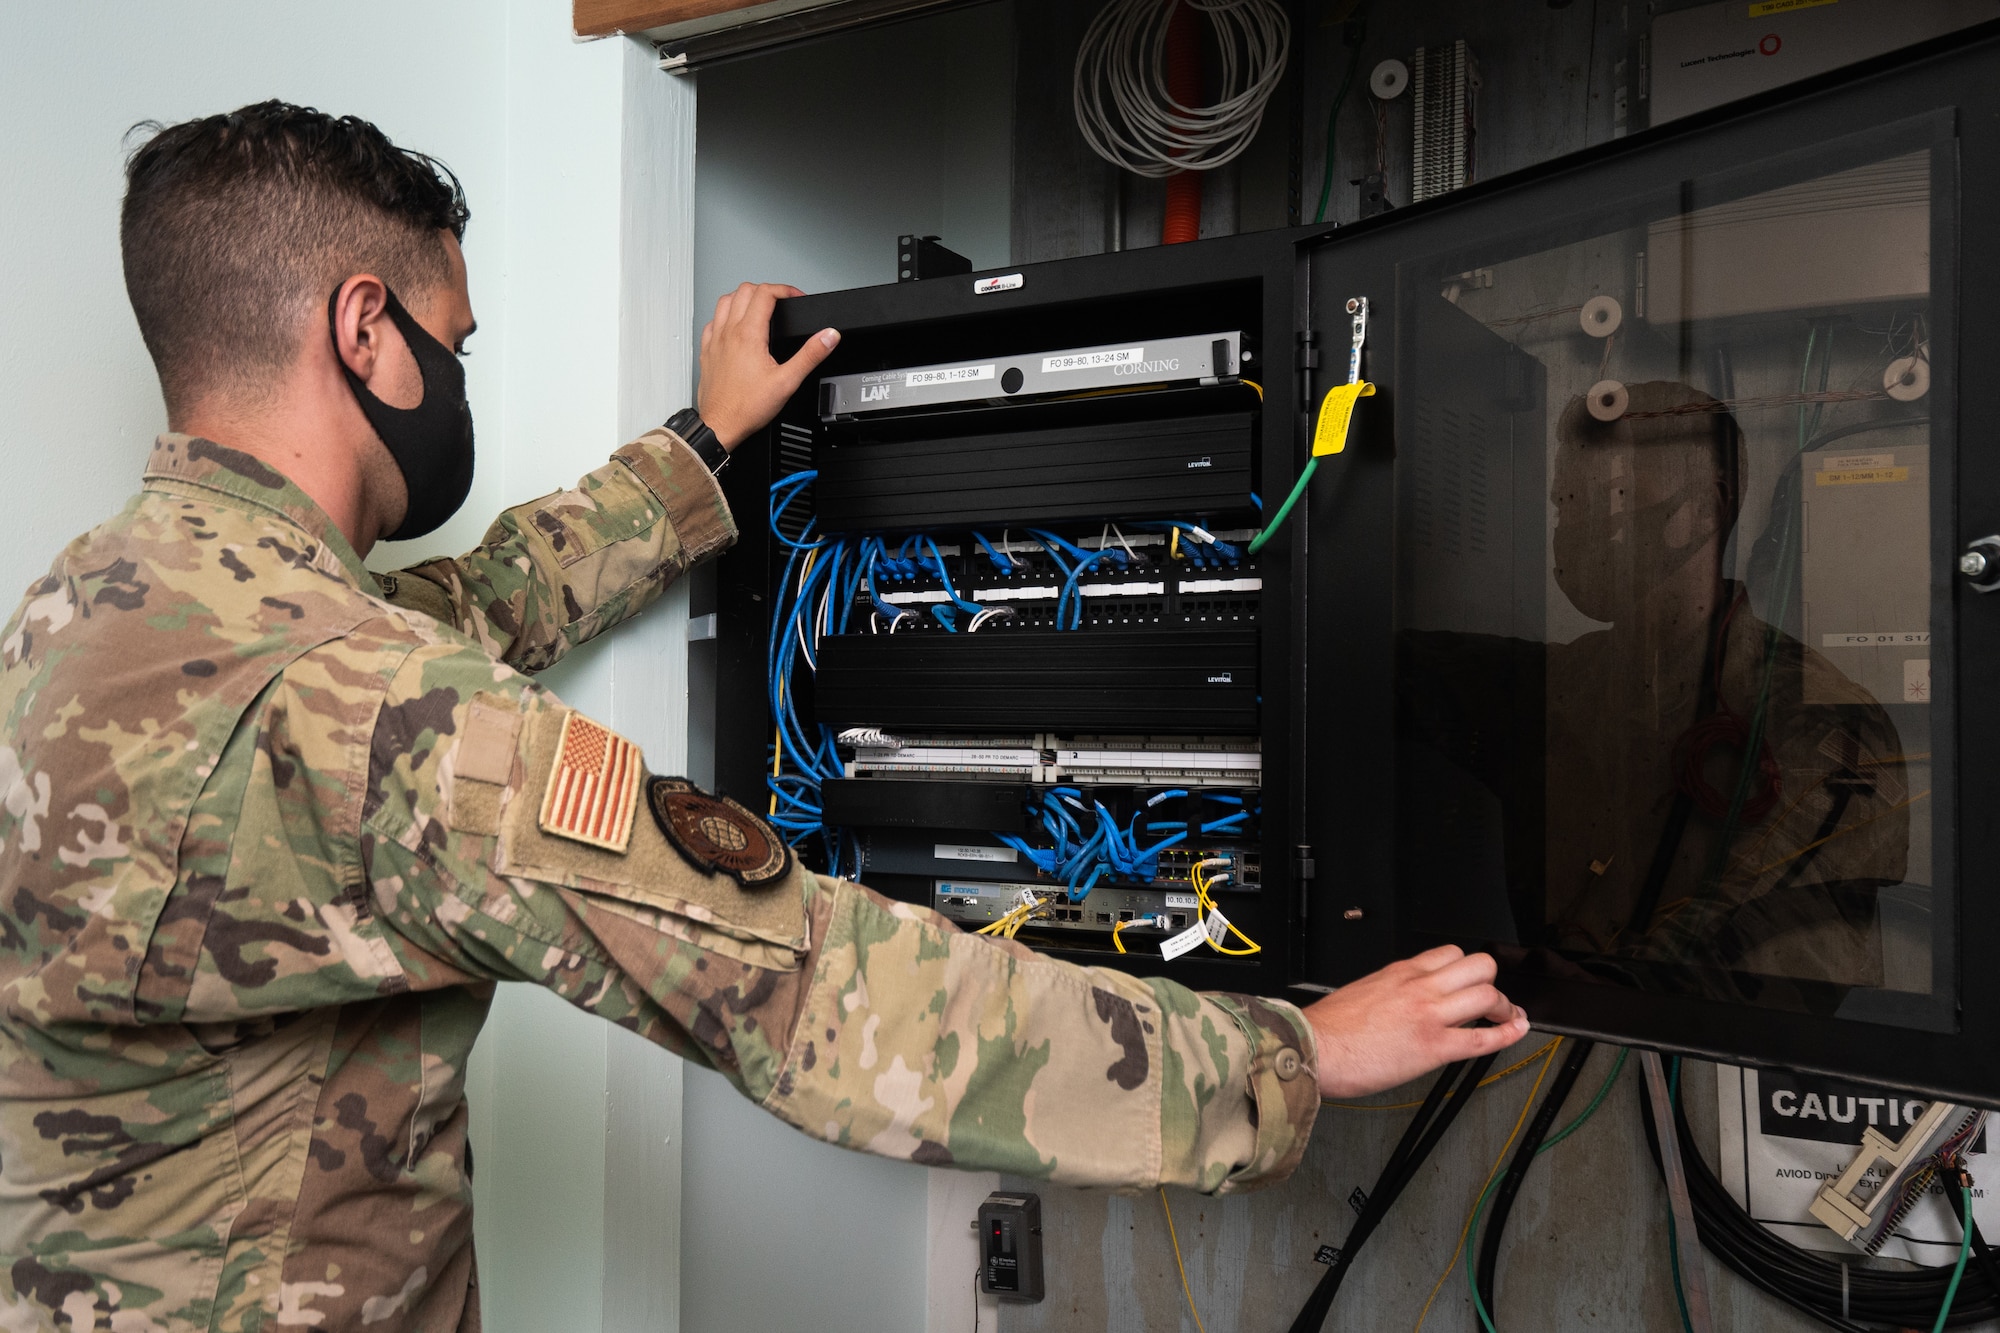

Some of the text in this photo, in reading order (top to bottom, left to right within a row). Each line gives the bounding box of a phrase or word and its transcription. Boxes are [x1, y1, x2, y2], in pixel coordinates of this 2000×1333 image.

[1680, 46, 1756, 68] Lucent Technologies
[1050, 352, 1129, 368] FO 99-80, 13-24 SM
[1114, 358, 1180, 376] CORNING
[862, 374, 882, 383] Corning
[882, 372, 897, 381] Cable
[913, 369, 979, 383] FO 99-80, 1-12 SM
[861, 385, 890, 402] LAN
[1167, 896, 1198, 905] 10.10.10.2
[1771, 1089, 1927, 1127] CAUTIO
[1775, 1167, 1812, 1179] AVIOD
